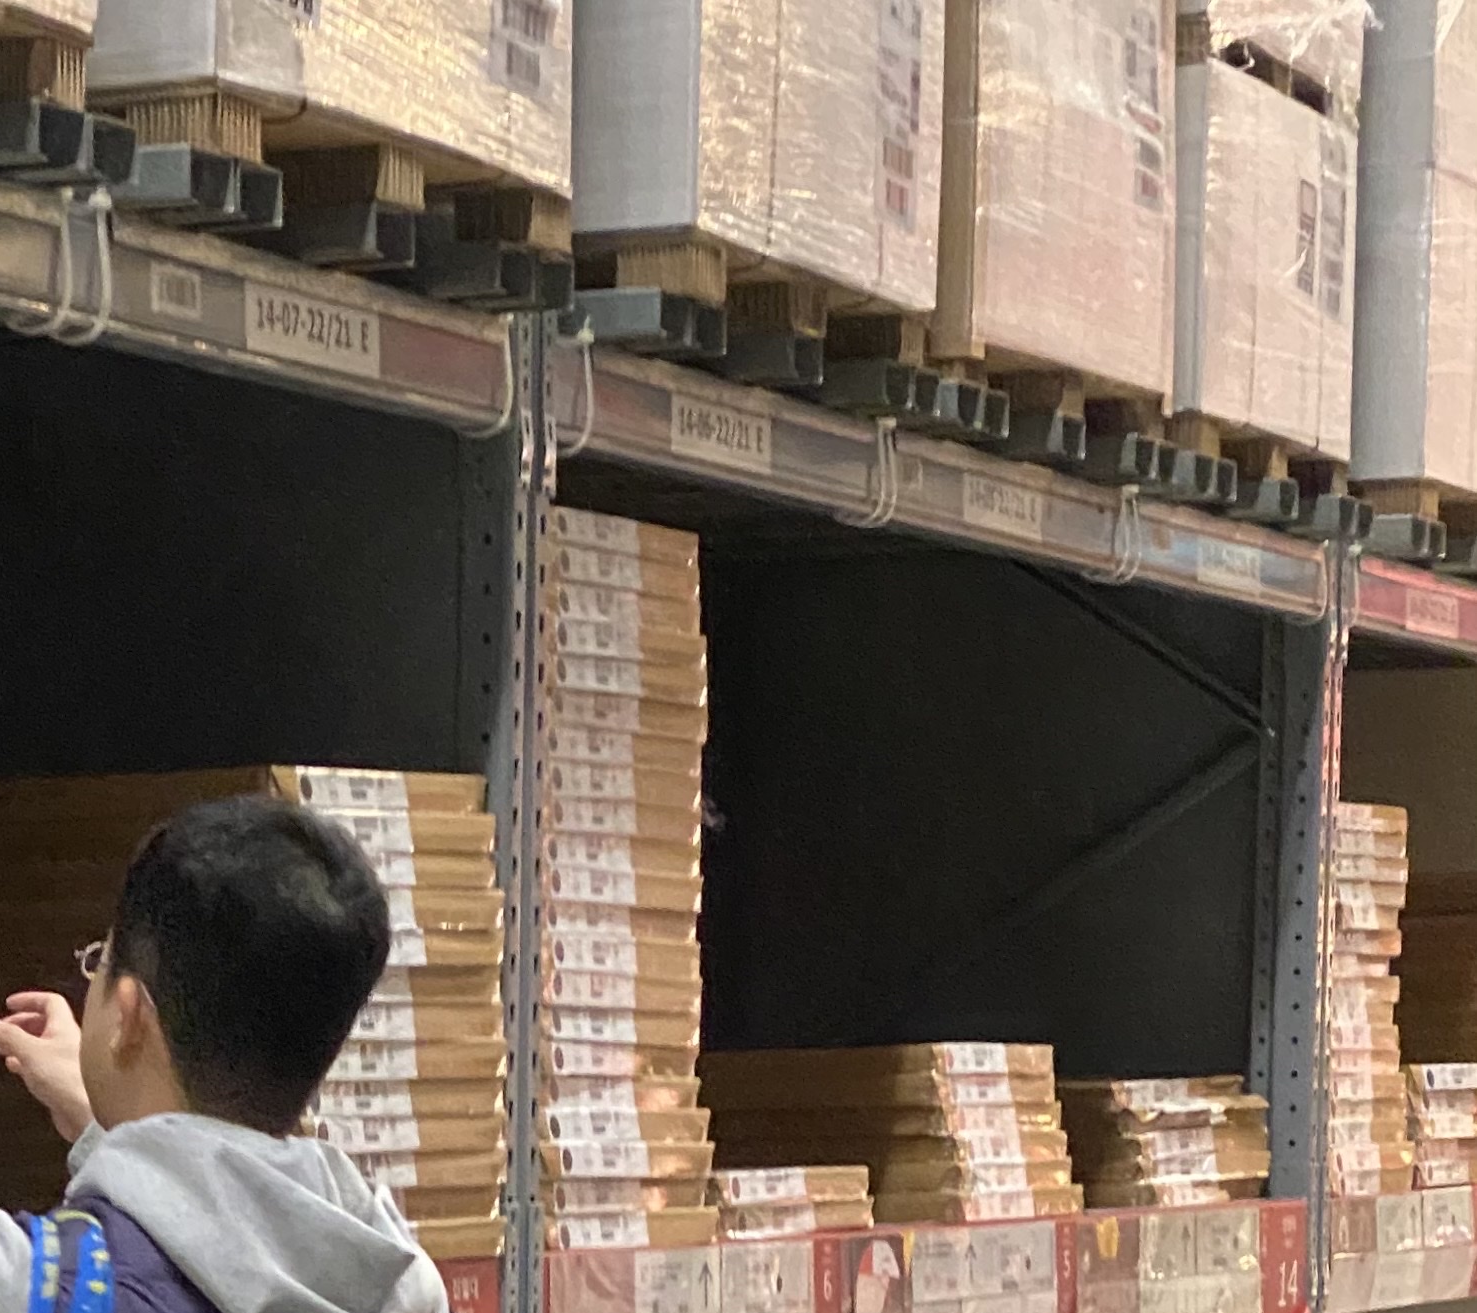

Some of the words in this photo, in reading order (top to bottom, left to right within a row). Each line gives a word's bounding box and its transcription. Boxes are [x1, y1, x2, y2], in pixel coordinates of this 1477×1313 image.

[257, 298, 352, 349] 14-07-22/21
[360, 320, 369, 353] E
[823, 1268, 833, 1301] 6
[1278, 1258, 1299, 1308] 14
